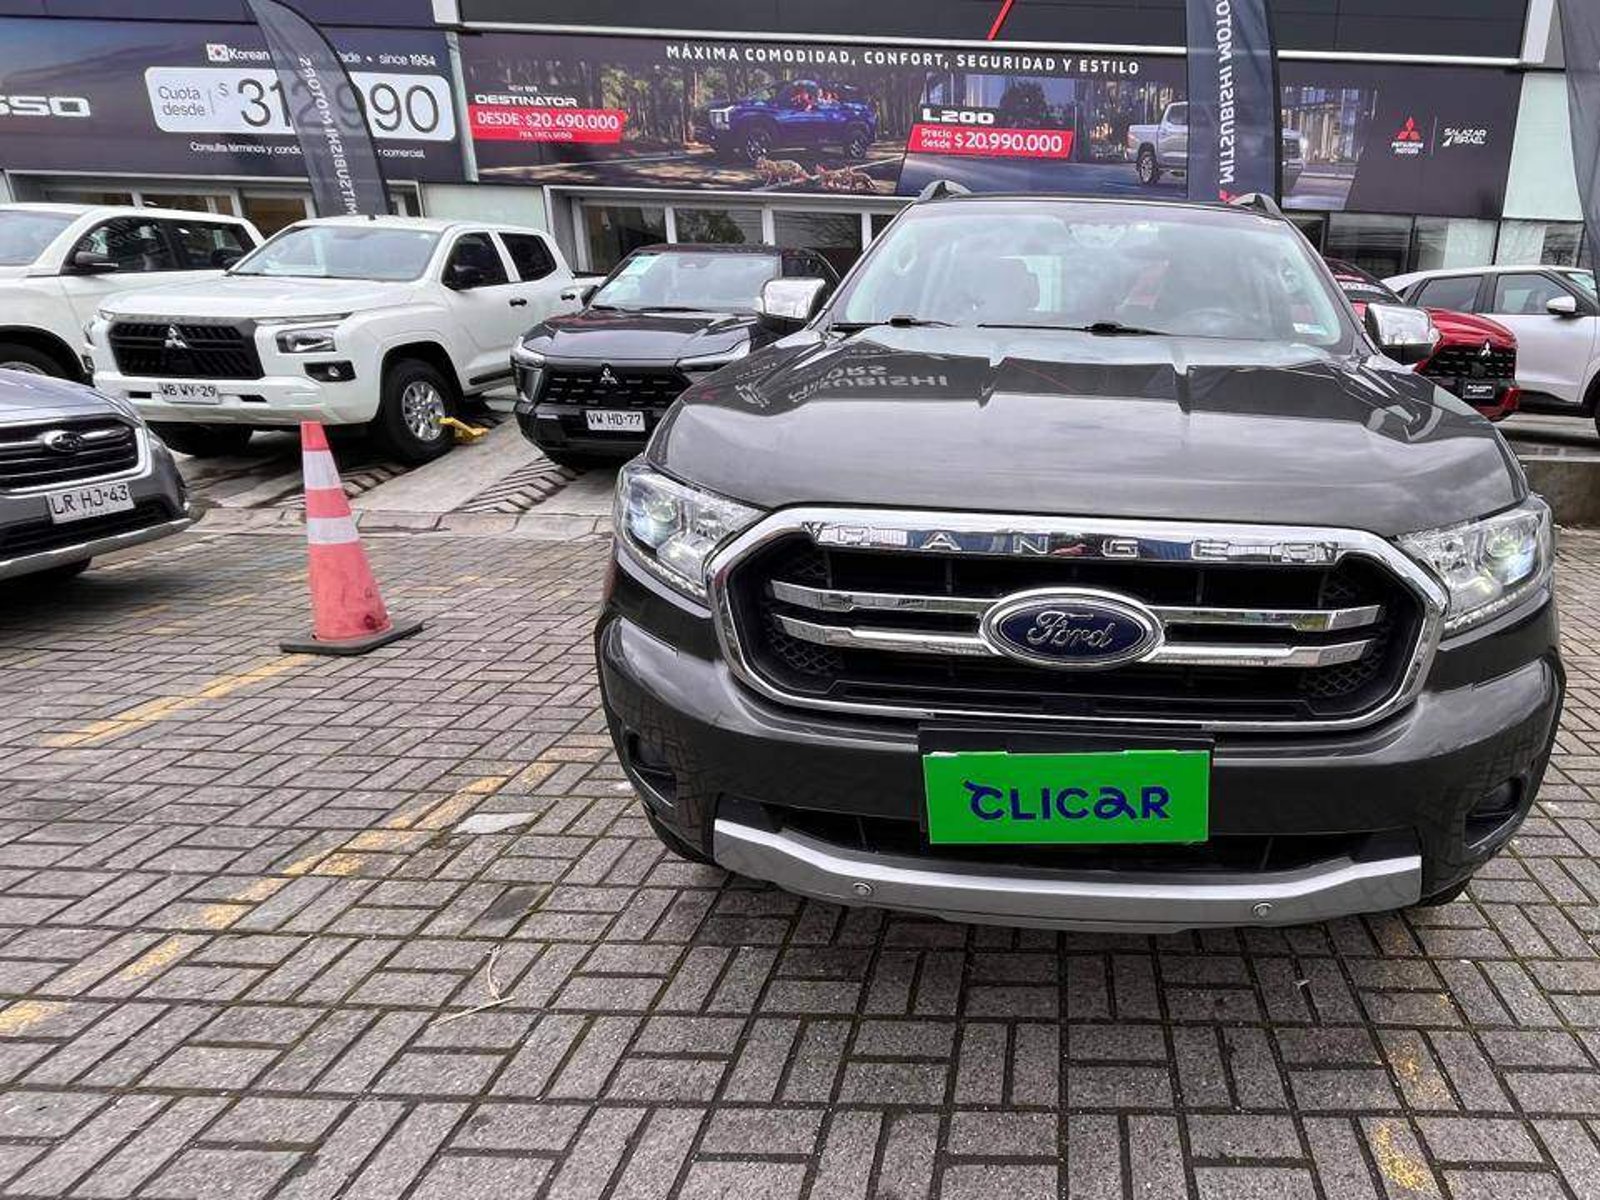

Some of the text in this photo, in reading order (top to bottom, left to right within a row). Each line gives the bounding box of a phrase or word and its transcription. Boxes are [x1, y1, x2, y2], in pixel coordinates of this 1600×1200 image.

[227, 48, 270, 61] Korean
[379, 52, 408, 65] since
[409, 54, 437, 67] 1954
[666, 43, 1139, 74] MÁXIMA COMODIDAD, CONFORT, SEGURIDAD Y ESTILO
[158, 86, 201, 100] Cuota
[475, 94, 578, 107] DESTINATOR
[0, 95, 91, 117] SO
[162, 102, 206, 116] desde
[922, 108, 995, 124] L200
[920, 128, 952, 138] Precio
[921, 139, 950, 149] desde
[51, 494, 77, 514] LR
[836, 525, 1318, 562] RANGER
[1026, 610, 1116, 648] Ford
